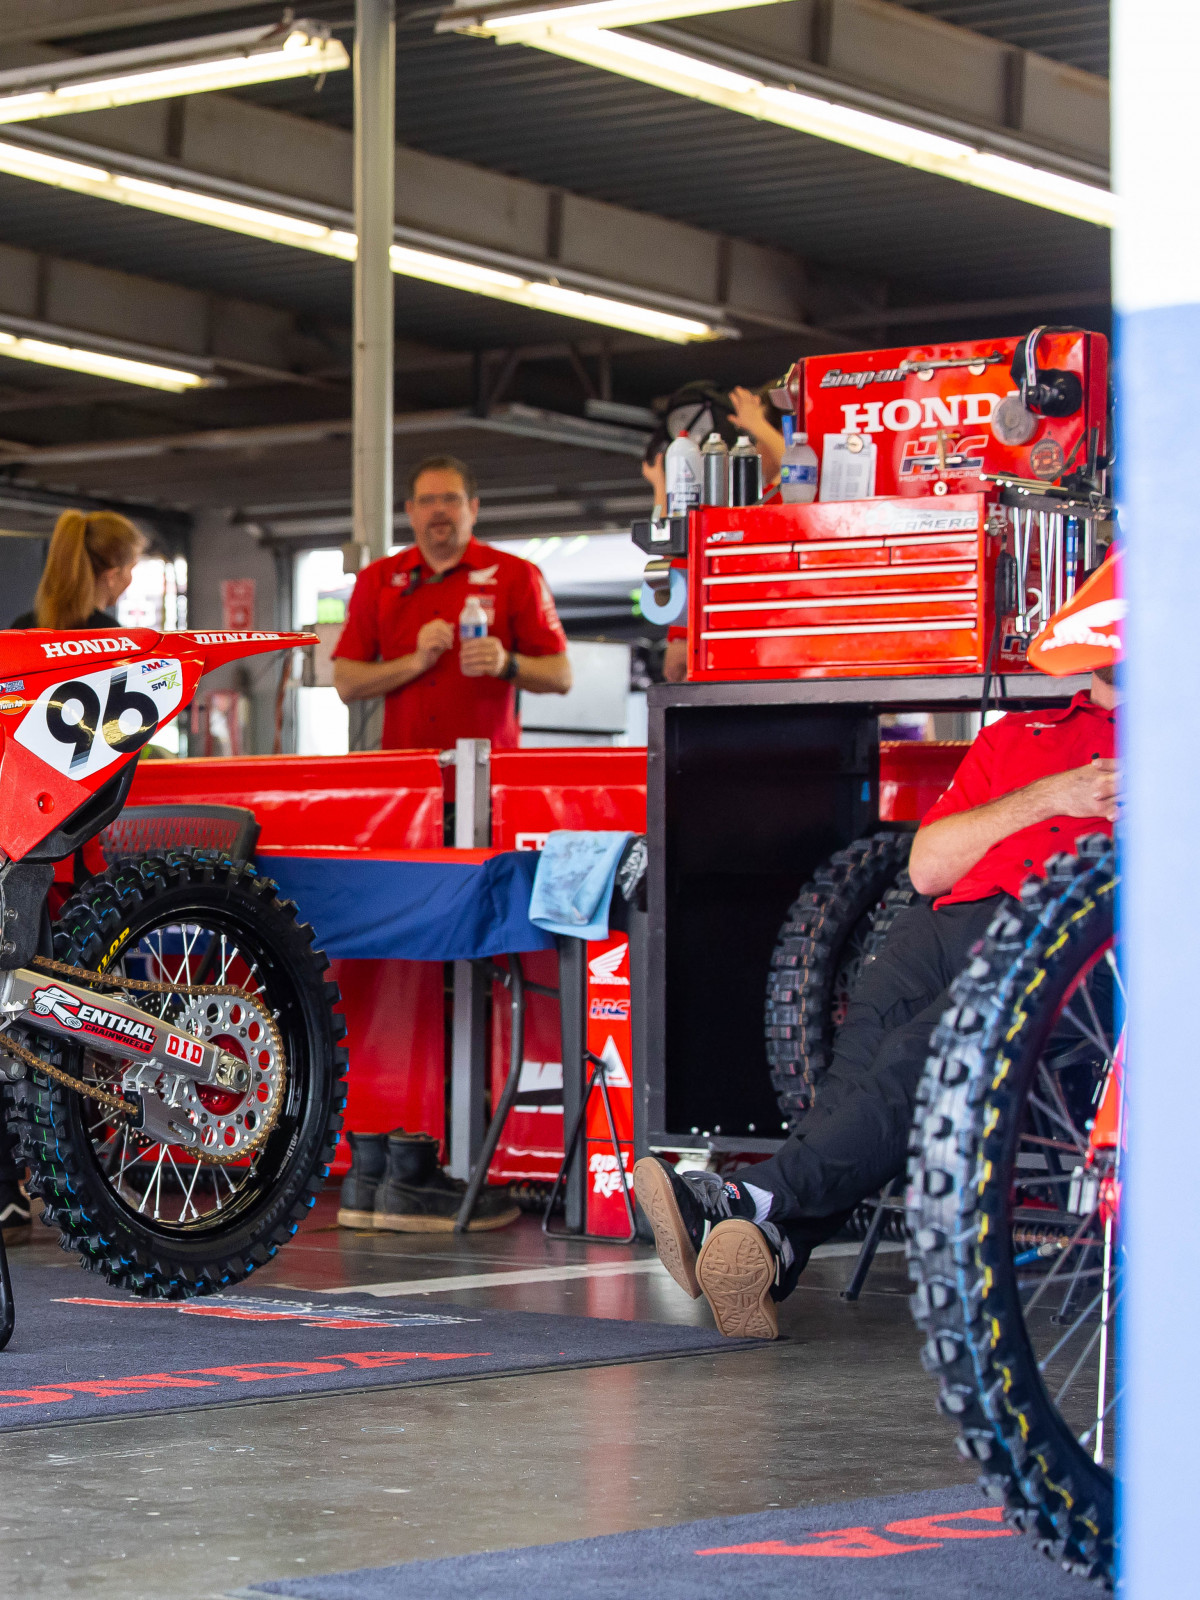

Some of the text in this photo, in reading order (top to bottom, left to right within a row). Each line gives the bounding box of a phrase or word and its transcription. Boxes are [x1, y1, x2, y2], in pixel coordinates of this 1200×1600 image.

[840, 391, 1046, 434] HOND
[41, 637, 141, 659] HONDA
[141, 659, 170, 675] AMA
[151, 673, 181, 692] SMX
[46, 668, 159, 775] 96
[84, 1023, 151, 1052] CHAINWHEELS
